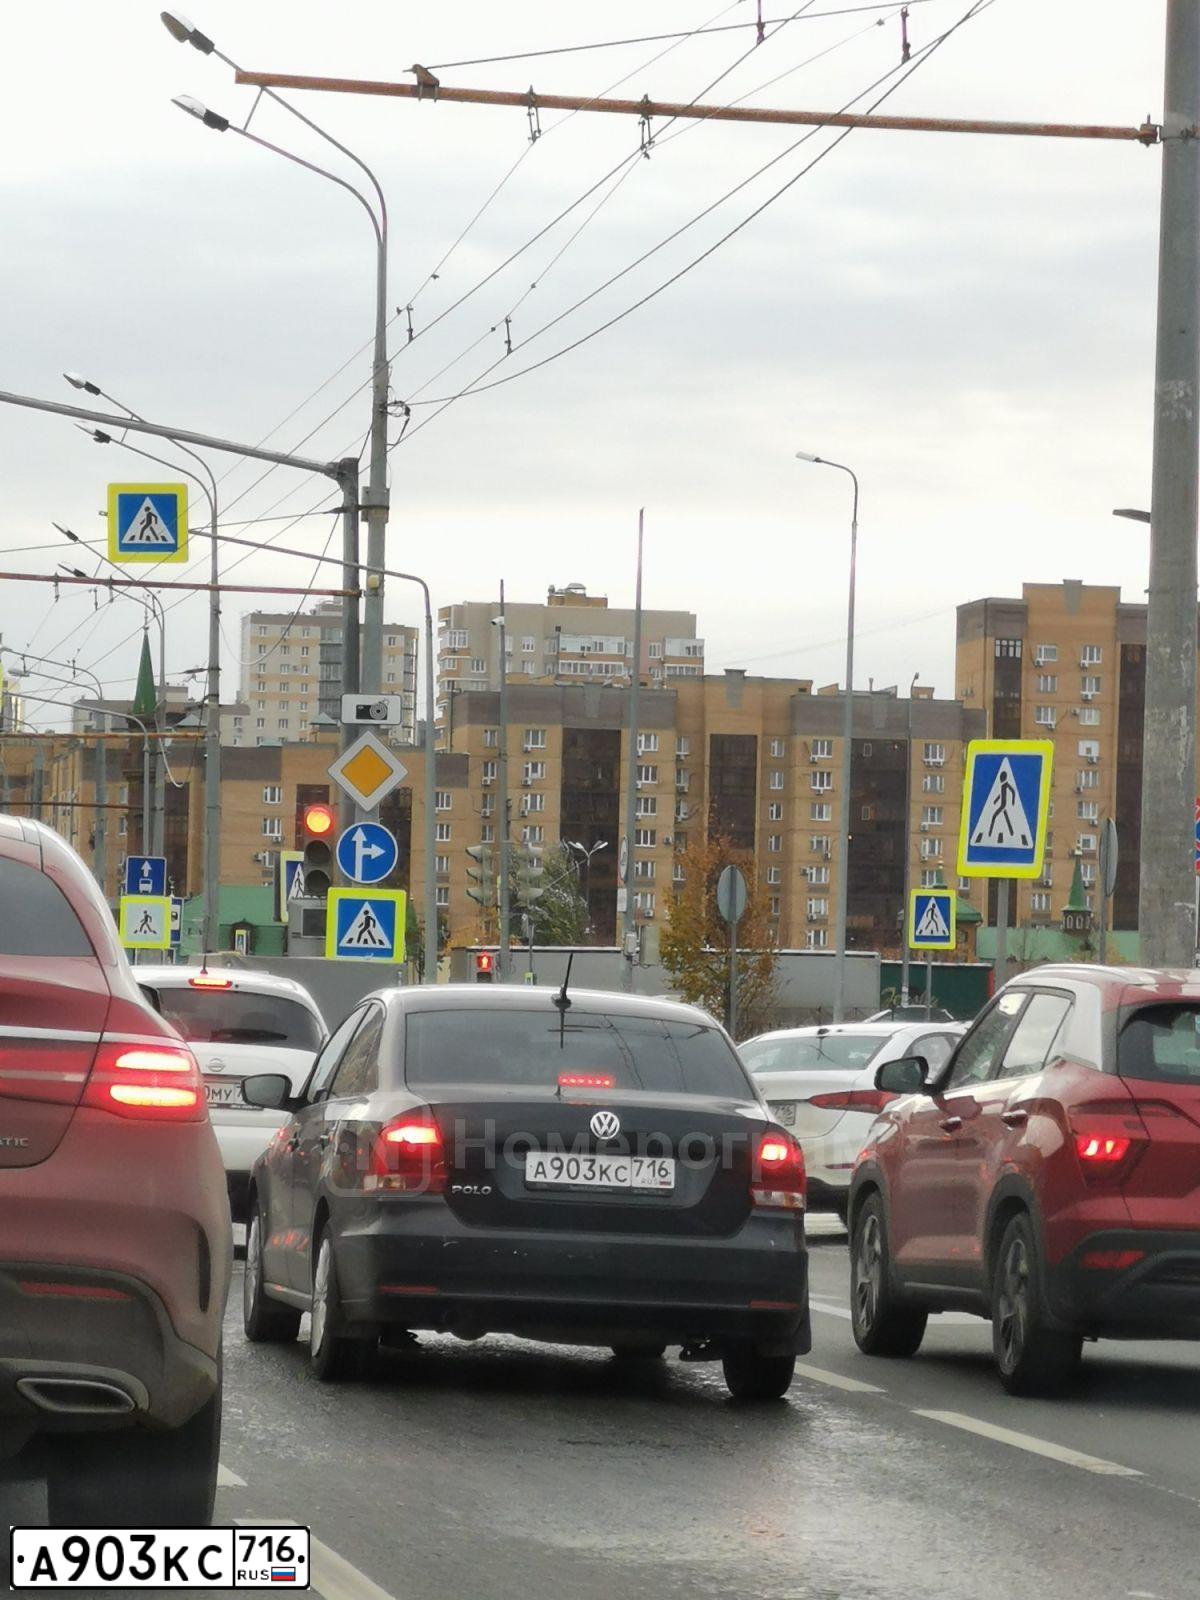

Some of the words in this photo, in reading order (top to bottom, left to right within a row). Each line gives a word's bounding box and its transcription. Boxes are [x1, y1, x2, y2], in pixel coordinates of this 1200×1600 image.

[533, 1156, 628, 1183] А903КС
[633, 1159, 670, 1178] 716
[452, 1185, 492, 1195] POLO
